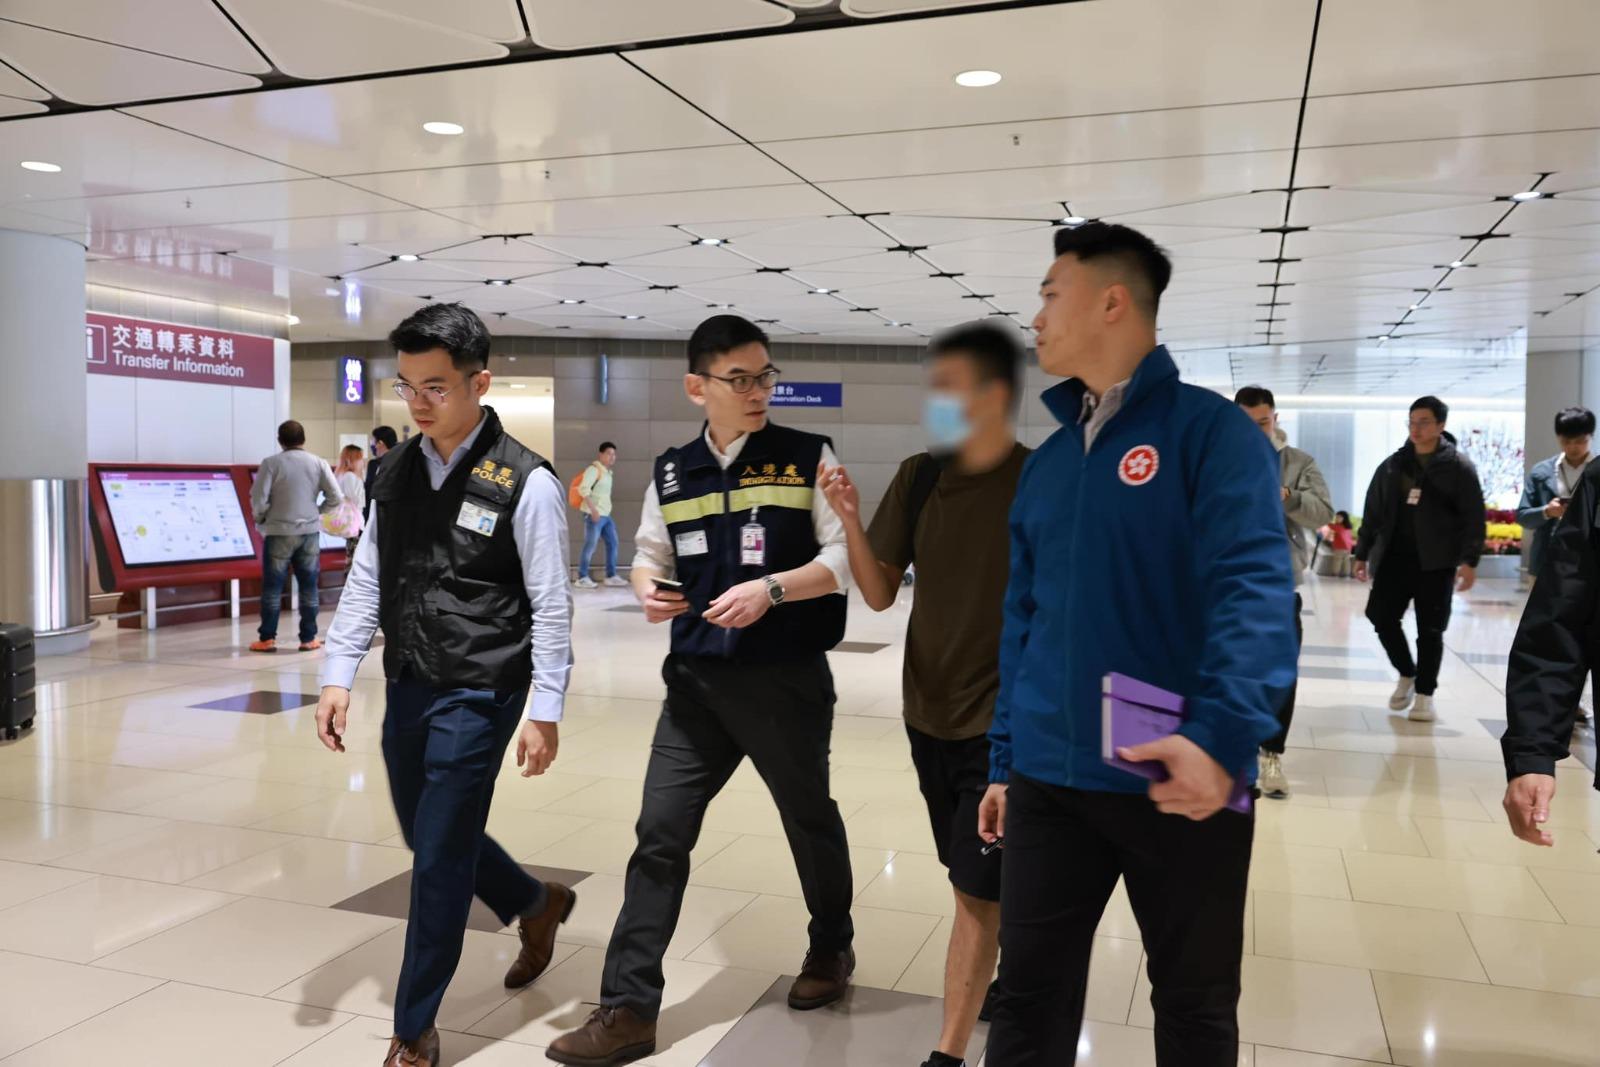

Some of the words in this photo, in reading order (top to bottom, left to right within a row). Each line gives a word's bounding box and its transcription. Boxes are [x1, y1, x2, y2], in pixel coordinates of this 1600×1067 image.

[112, 323, 234, 360] 交通轉乘資料
[112, 350, 170, 370] Transfer
[173, 356, 244, 378] Information
[806, 395, 822, 403] Deck
[471, 467, 514, 488] POLICE
